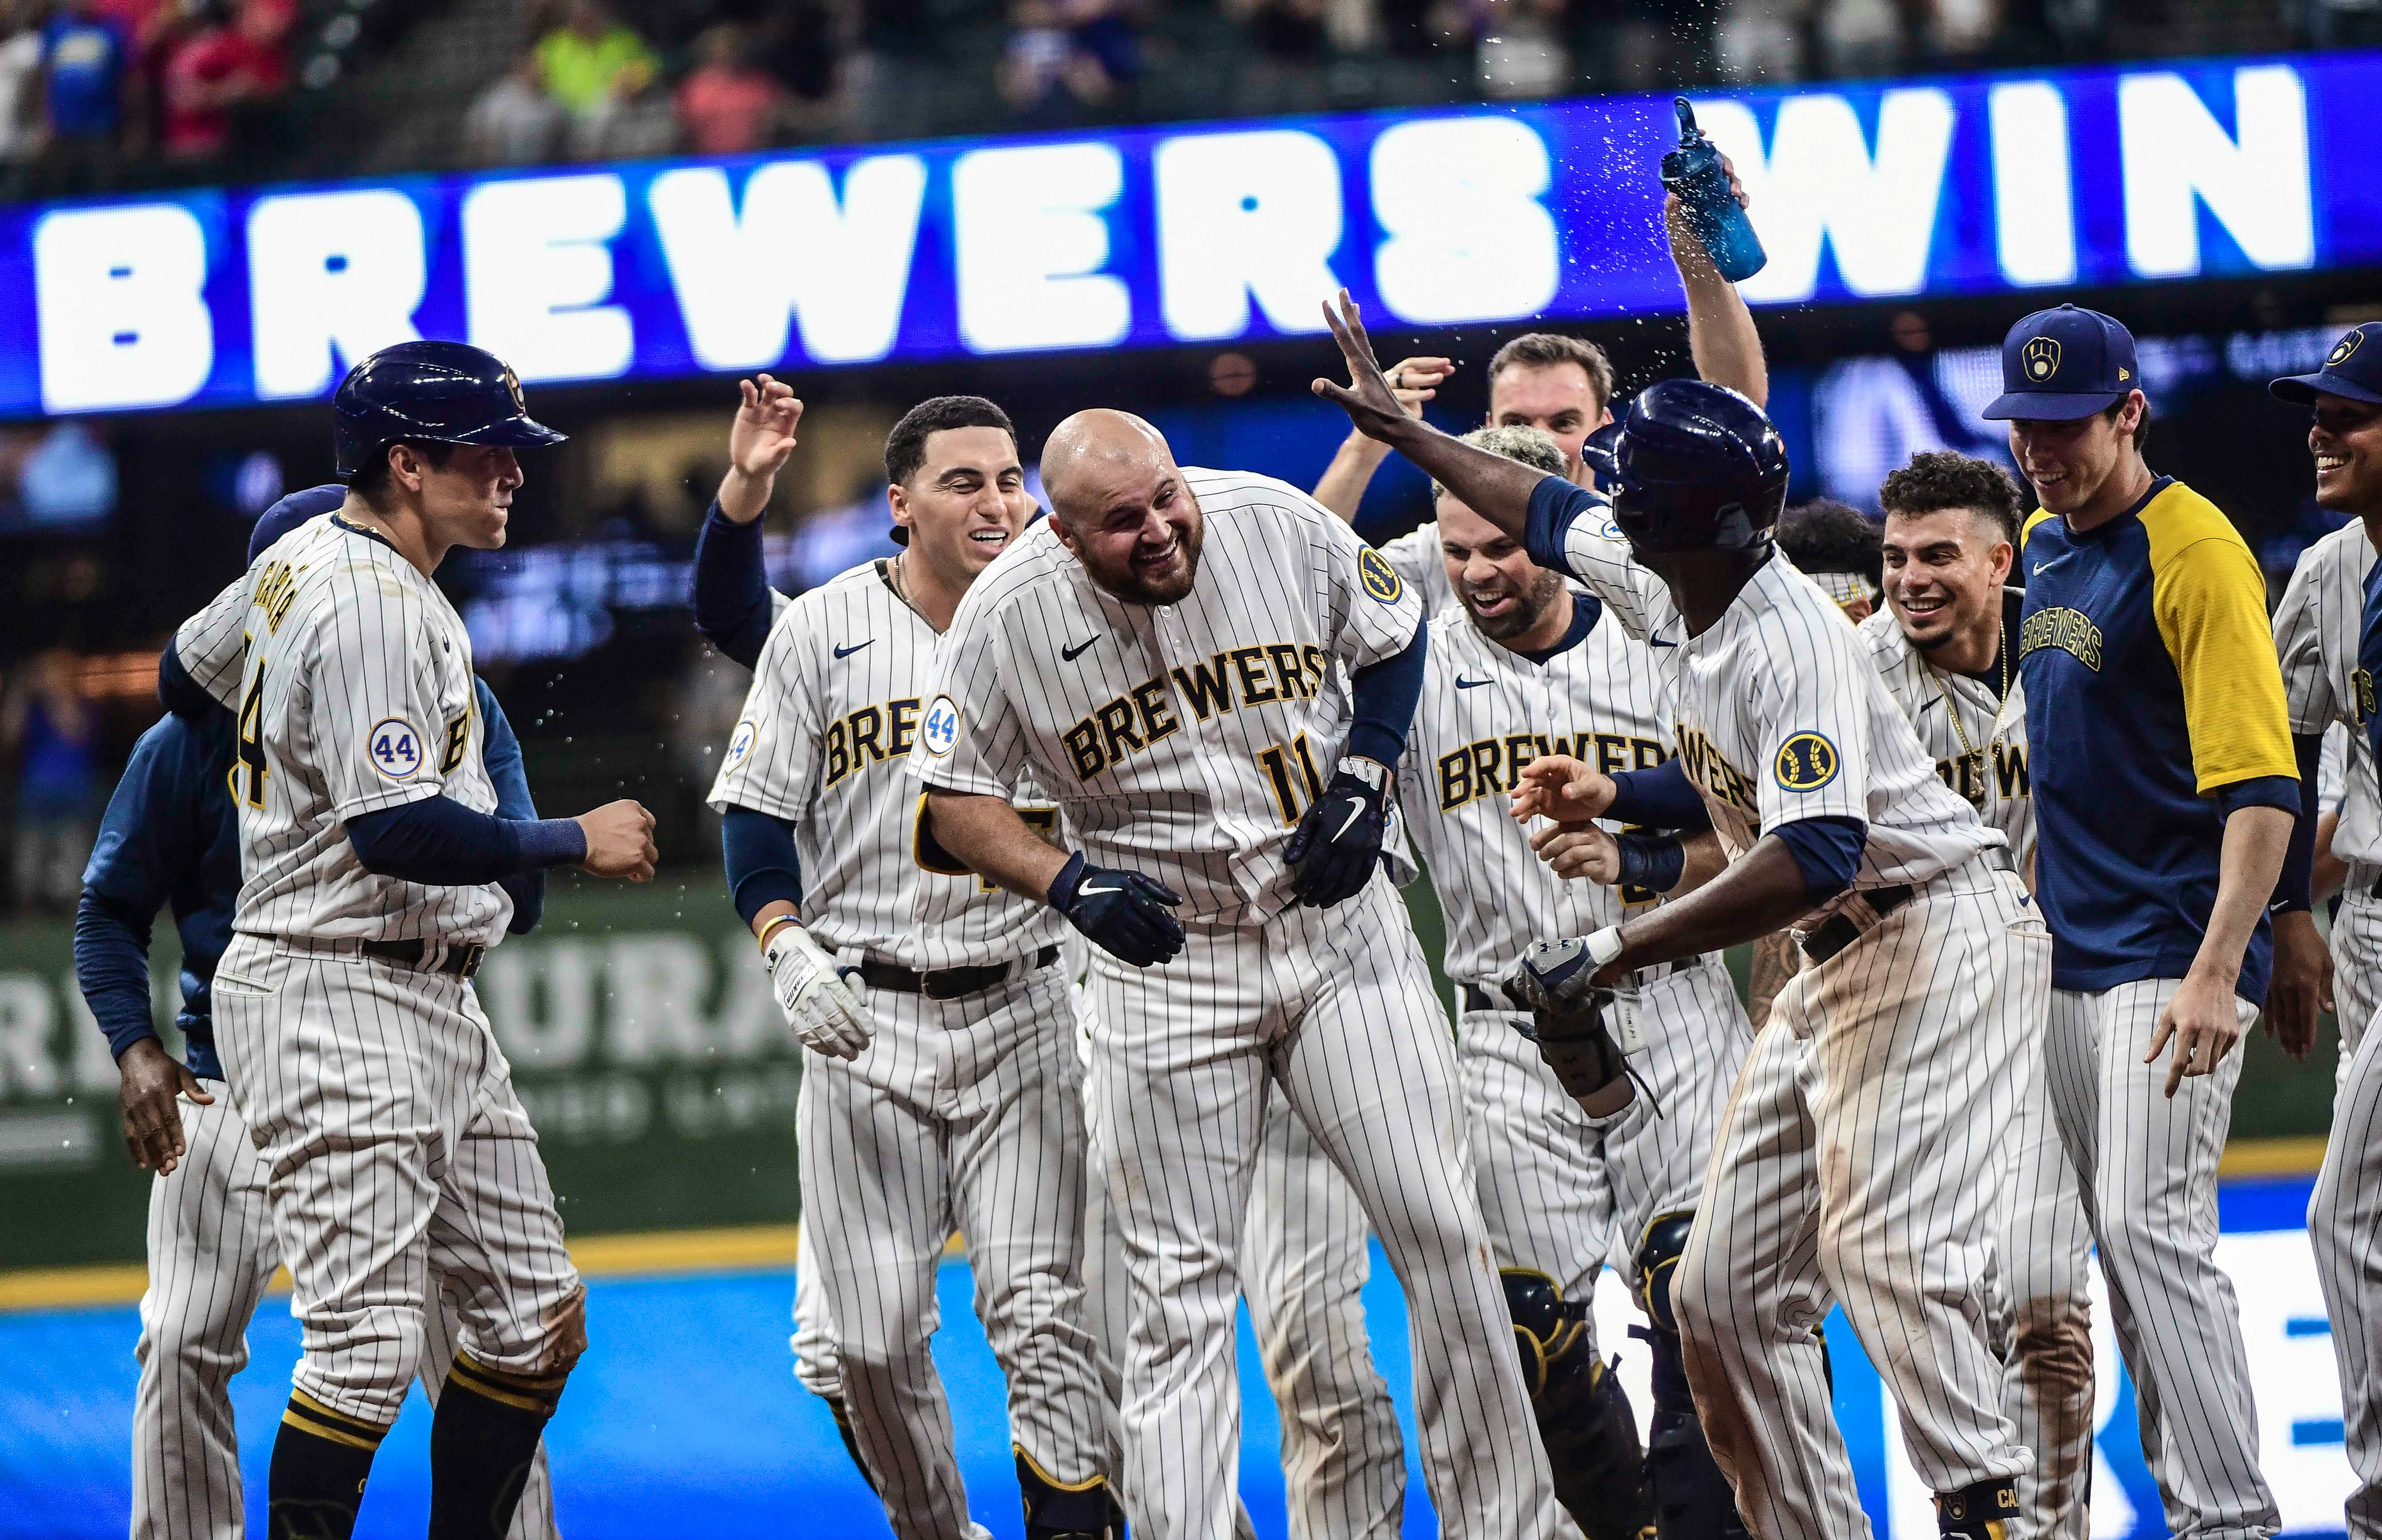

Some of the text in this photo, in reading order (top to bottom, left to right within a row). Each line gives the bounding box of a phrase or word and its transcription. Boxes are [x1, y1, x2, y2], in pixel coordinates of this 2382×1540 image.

[33, 64, 2315, 413] BREWERS WIN
[2019, 607, 2102, 672] BREWERS
[928, 709, 955, 743] 44
[1062, 643, 1326, 782] BREWERS
[374, 734, 416, 764] 44
[1258, 728, 1324, 828] 11
[1997, 1489, 2020, 1508] CA
